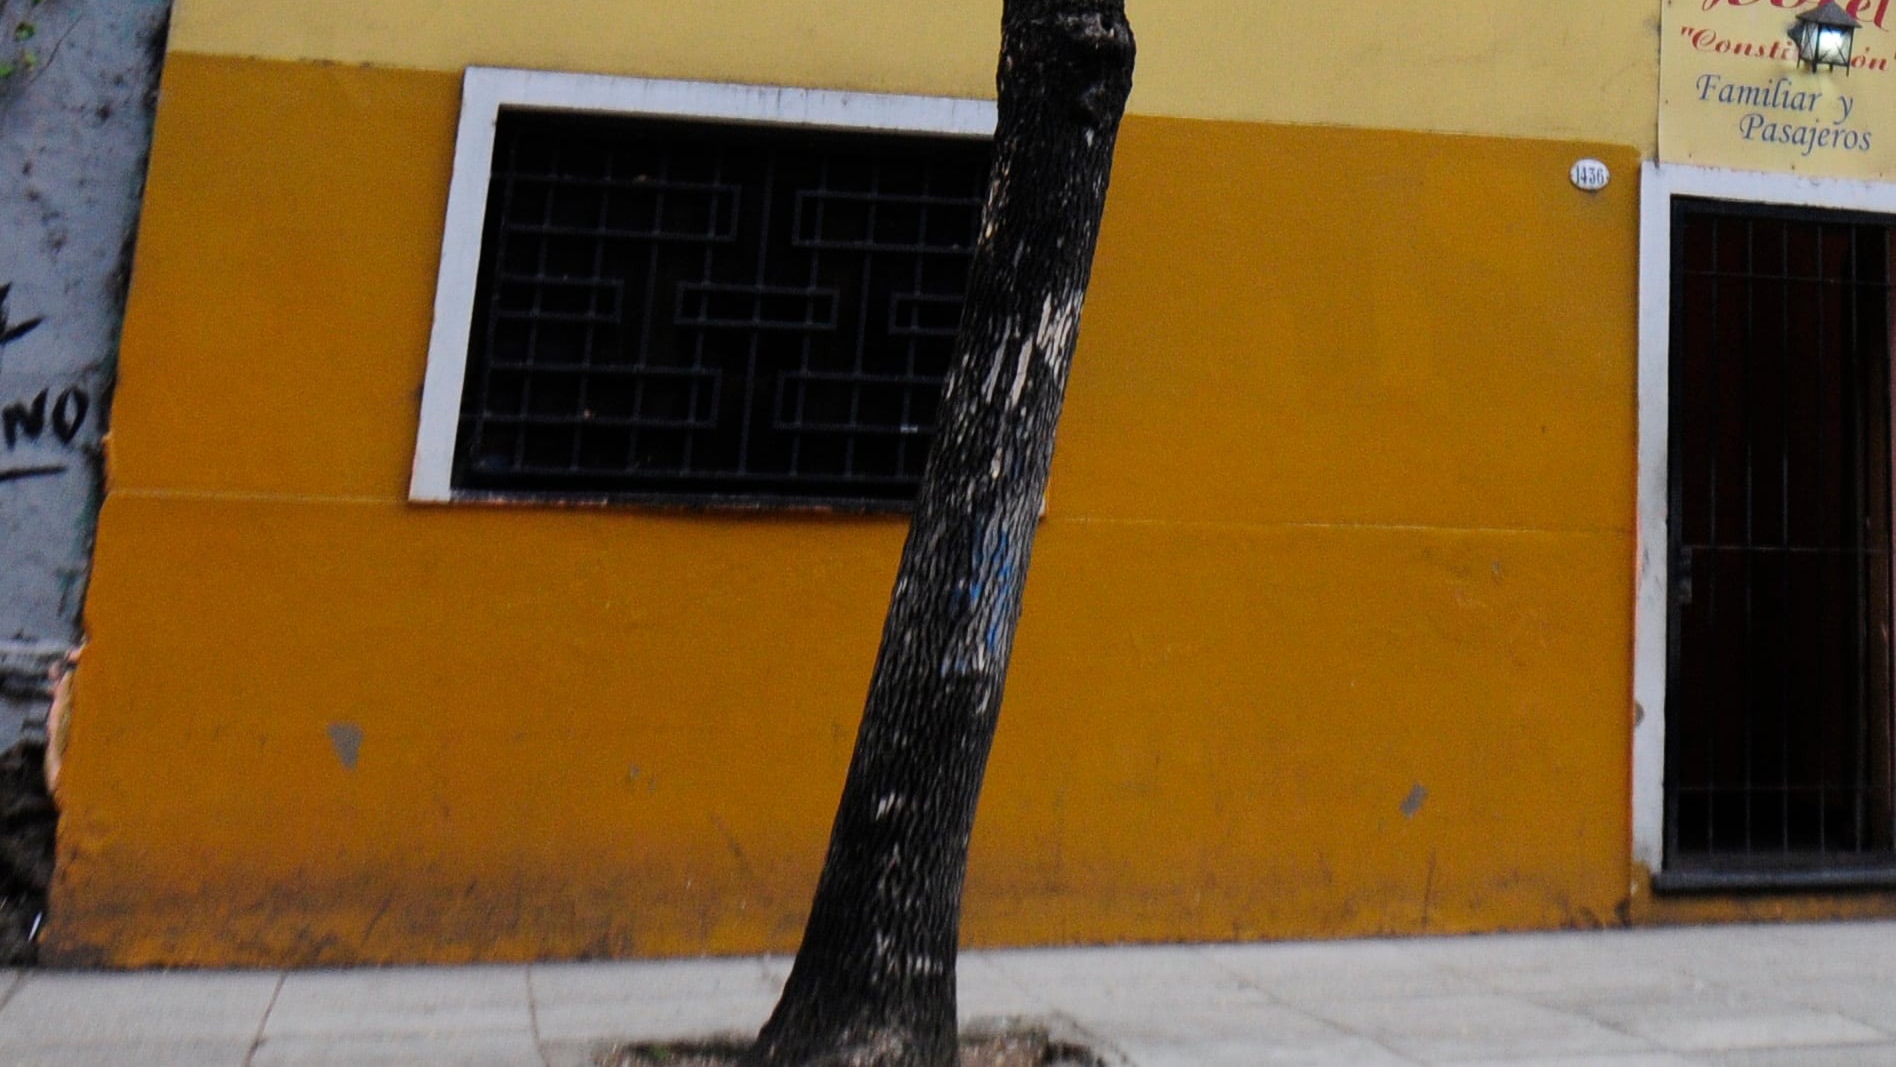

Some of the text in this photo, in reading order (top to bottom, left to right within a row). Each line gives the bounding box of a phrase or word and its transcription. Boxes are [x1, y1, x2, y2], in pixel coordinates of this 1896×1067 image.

[1696, 73, 1854, 125] Familiar y
[1739, 112, 1873, 157] Pasajeros
[1575, 165, 1605, 186] 1436
